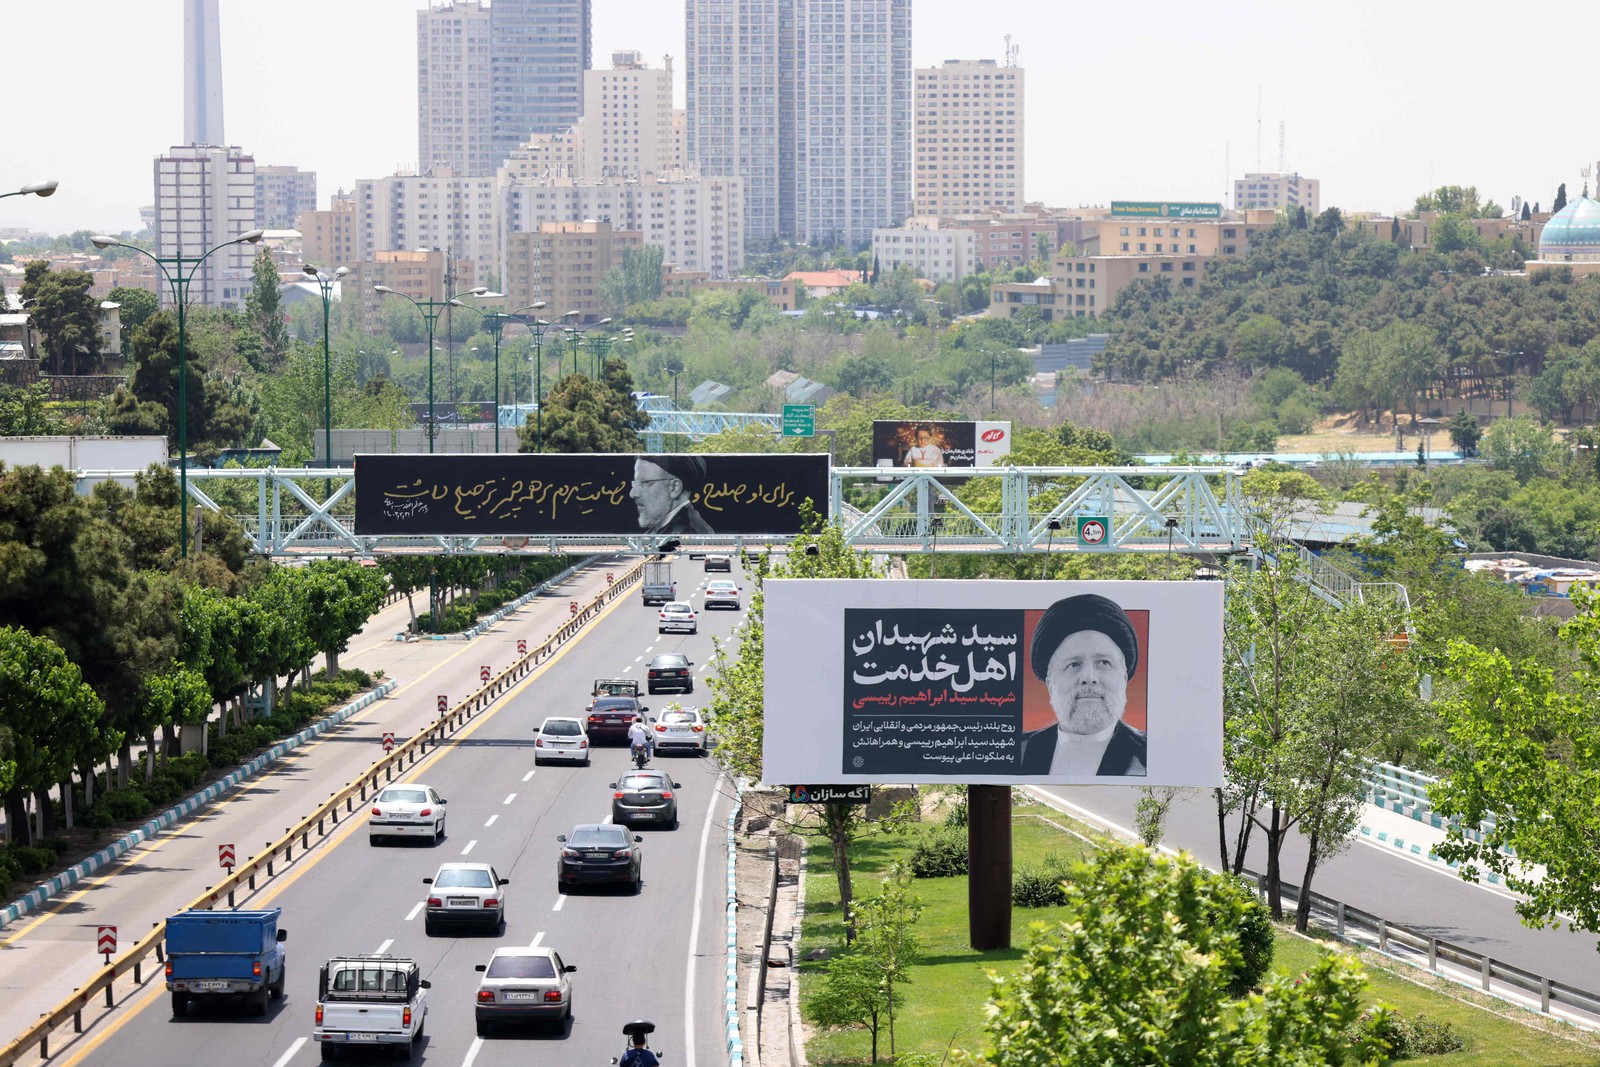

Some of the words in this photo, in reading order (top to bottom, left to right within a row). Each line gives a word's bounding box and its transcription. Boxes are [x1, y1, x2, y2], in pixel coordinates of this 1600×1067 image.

[384, 479, 448, 499] داشت
[519, 480, 542, 502] همه
[576, 472, 626, 514] رضایت
[746, 484, 762, 504] او
[763, 482, 795, 507] برای
[454, 479, 498, 520] ترجیح
[490, 476, 523, 518] چیز
[536, 484, 553, 514] بر
[552, 484, 579, 520] مردم
[692, 492, 700, 504] و
[703, 482, 746, 511] صلاح
[962, 624, 1017, 652] سید
[853, 654, 960, 685] خدمت
[951, 651, 1016, 692] اهل
[852, 692, 896, 709] رییسی
[900, 689, 948, 707] ابراهیم
[950, 692, 978, 706] سید
[980, 692, 1016, 707] شهید
[852, 721, 873, 732] ایران
[874, 721, 900, 732] انقلابی
[900, 724, 906, 732] و
[906, 722, 932, 732] مردمی
[984, 722, 1000, 732] بلند
[1000, 723, 1016, 732] روح
[852, 737, 898, 748] همراهانش
[904, 740, 934, 748] رییسی
[934, 736, 968, 748] ابراهیم
[968, 739, 988, 748] سید
[989, 738, 1016, 748] شهید
[922, 753, 954, 764] پیوست
[955, 752, 974, 763] اعلی
[975, 752, 1005, 762] ملکوت
[1006, 754, 1014, 763] به
[811, 788, 846, 801] سازان
[848, 787, 869, 798] آگه
